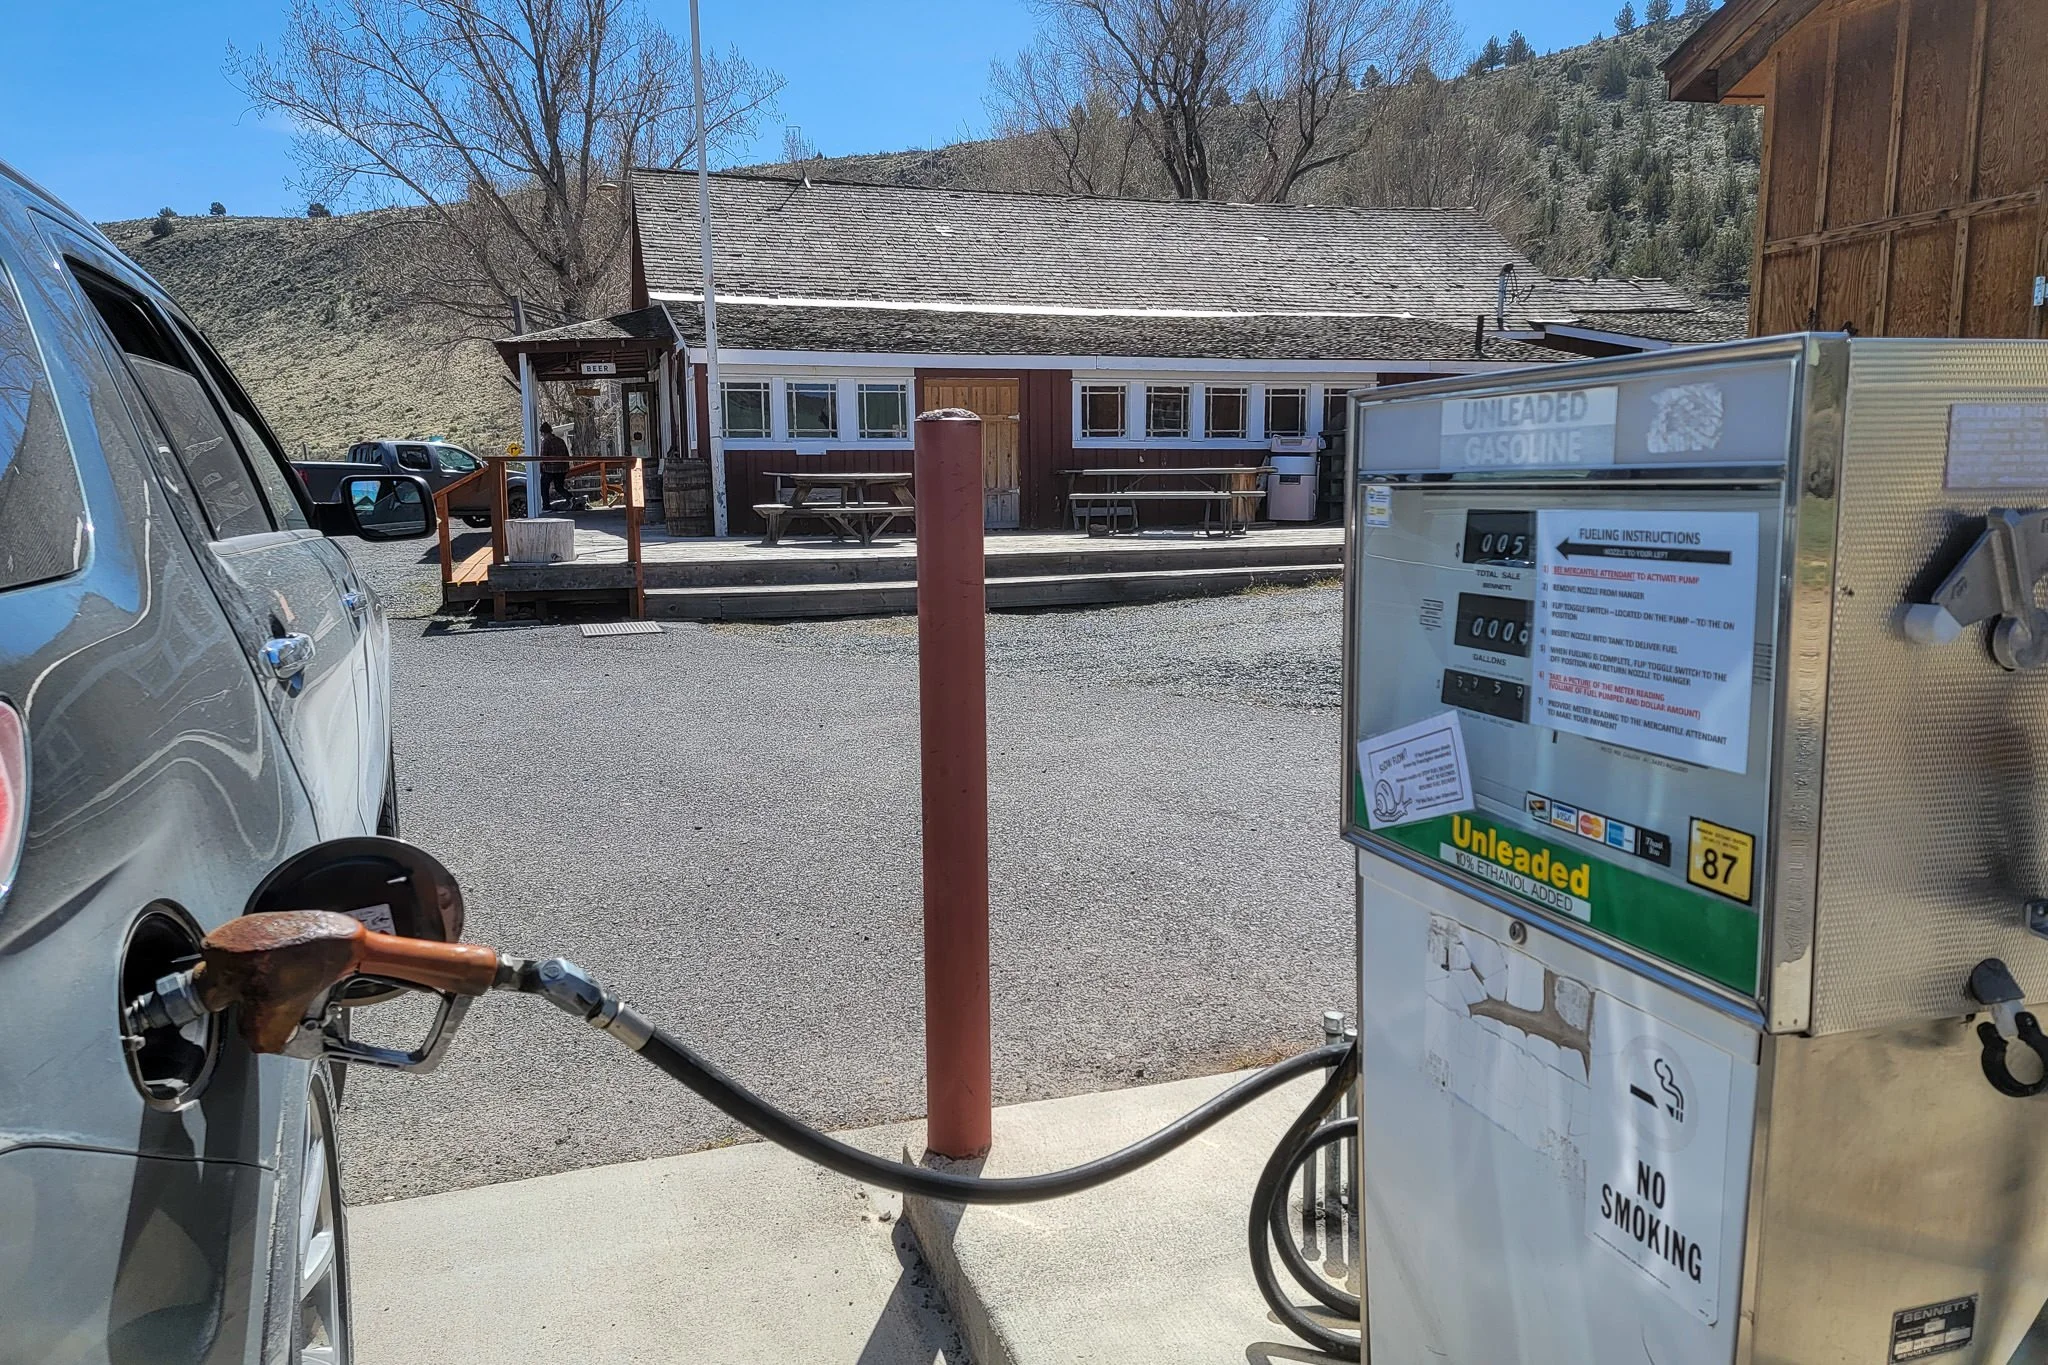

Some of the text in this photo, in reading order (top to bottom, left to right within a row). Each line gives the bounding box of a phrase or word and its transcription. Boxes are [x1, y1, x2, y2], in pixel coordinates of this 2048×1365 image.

[1462, 391, 1588, 430] UNLEADED
[1465, 430, 1582, 466] GASOLINE
[1580, 528, 1701, 545] FUELING INSTRUCTIONS
[1627, 549, 1636, 557] TO
[1476, 570, 1521, 580] TOTAL SALE
[1600, 569, 1634, 580] ATTENDANT
[1637, 572, 1646, 580] TO
[1647, 573, 1677, 584] ACTIVATE
[1680, 576, 1700, 584] PUMP
[1552, 584, 1576, 592] REMOVE
[1577, 586, 1598, 595] NOZZLE
[1600, 588, 1618, 598] FROM
[1618, 591, 1644, 600] HANGER
[1552, 611, 1578, 620] POSITION
[1564, 603, 1585, 612] TOGGLE
[1586, 606, 1609, 615] SWITCH
[1614, 608, 1642, 620] LOCATED
[1643, 612, 1653, 620] ON
[1655, 613, 1668, 622] THE
[1669, 615, 1690, 625] PUMP
[1696, 618, 1706, 627] TO
[1708, 620, 1721, 629] THE
[1723, 622, 1735, 630] ON
[1571, 632, 1591, 641] NOZZLE
[1608, 636, 1624, 646] TANK
[1626, 639, 1634, 648] TO
[1635, 640, 1661, 652] DELIVER
[1662, 644, 1678, 654] FUEL
[1472, 654, 1506, 666] GALLONS
[1550, 646, 1568, 655] WHEN
[1568, 648, 1592, 660] FUELING
[1648, 662, 1672, 673] TOGGLE
[1674, 666, 1701, 678] SWITCH
[1702, 670, 1712, 679] TO
[1713, 672, 1728, 682] THE
[1562, 657, 1588, 668] POSITION
[1589, 662, 1602, 670] AND
[1602, 664, 1626, 675] RETURN
[1628, 668, 1650, 680] NOZZLE
[1652, 672, 1662, 680] TO
[1584, 690, 1598, 698] FUEL
[1598, 692, 1624, 703] PUMPED
[1626, 697, 1639, 706] AND
[1640, 700, 1666, 711] DOLLAR
[1602, 683, 1614, 691] THE
[1614, 685, 1636, 696] METER
[1637, 689, 1664, 701] READING
[1548, 708, 1618, 730] TO MAKE YOUR PAYMENT
[1548, 700, 1572, 710] PROVIDE
[1572, 705, 1593, 714] METER
[1593, 709, 1620, 721] READING
[1620, 714, 1630, 724] TO
[1631, 717, 1642, 726] THE
[1644, 720, 1684, 736] MERCANTILE
[1686, 729, 1728, 745] ATTENDANT
[1556, 811, 1572, 822] VISA
[1452, 814, 1590, 898] Unleaded
[1702, 848, 1738, 884] 87
[1456, 851, 1573, 912] 10% ETHANOL ADDED
[1637, 1160, 1666, 1209] NO
[1601, 1183, 1702, 1284] SMOKING
[1903, 1300, 1969, 1324] BENNETT
